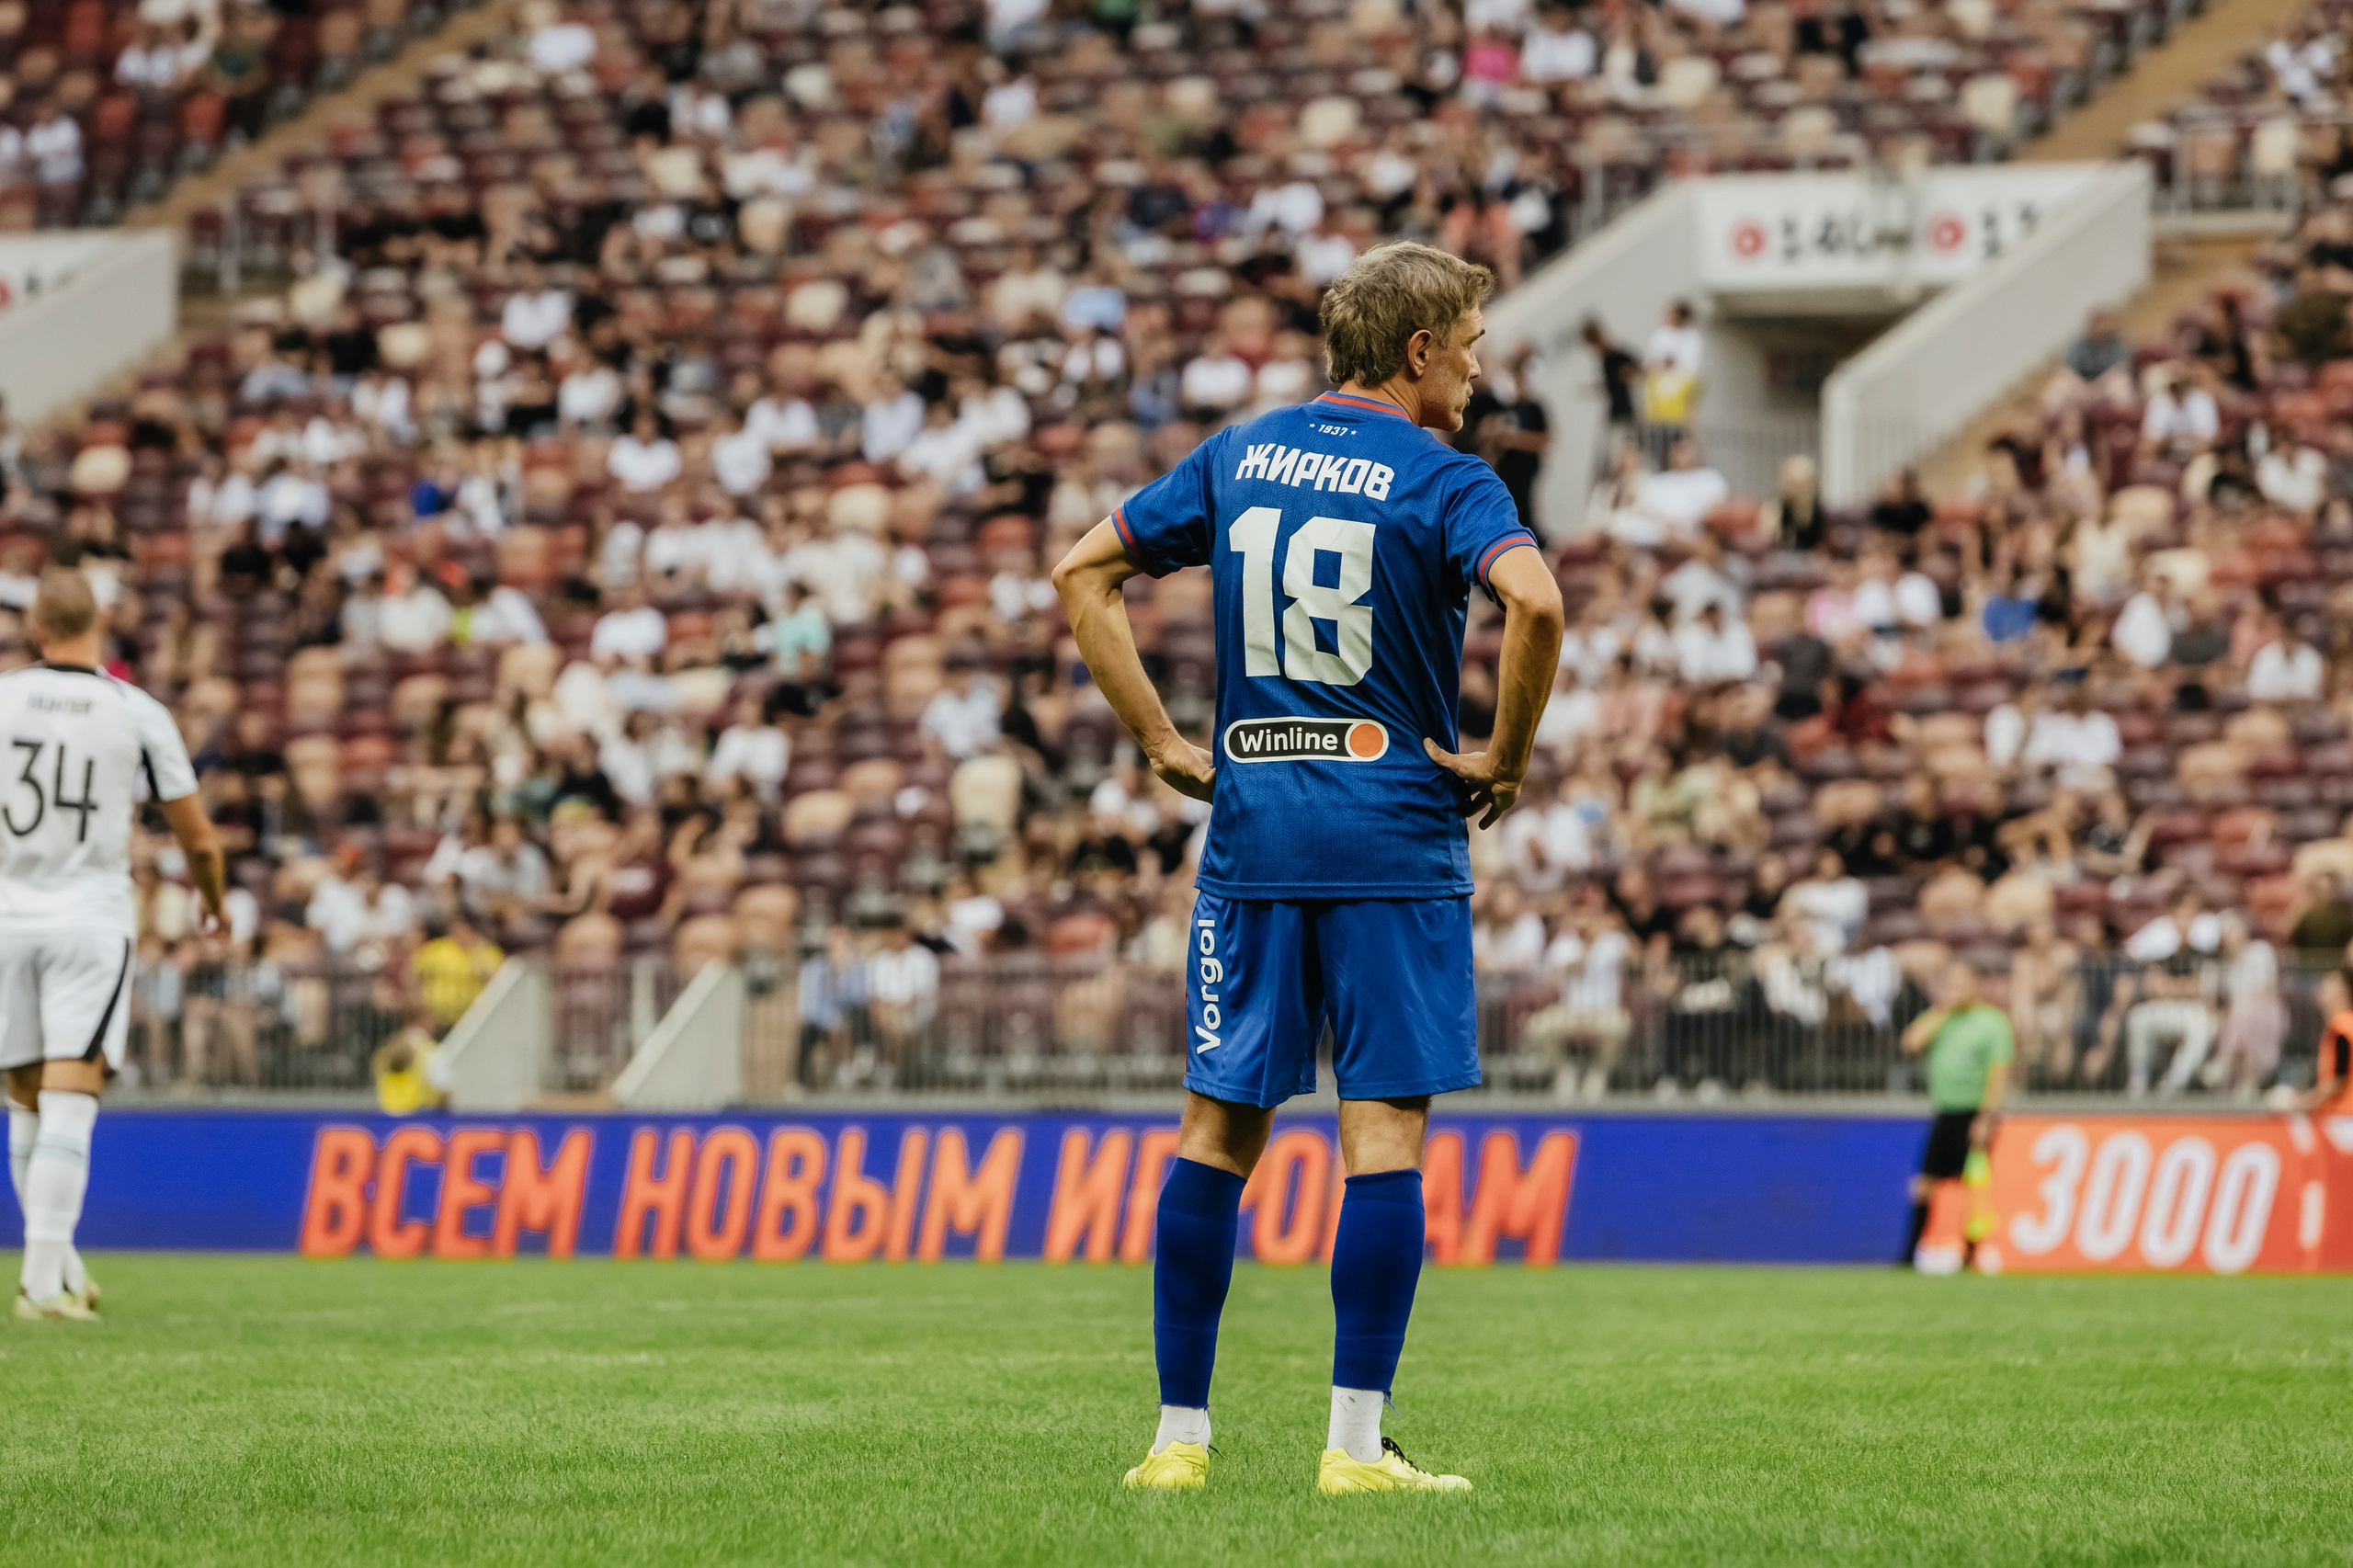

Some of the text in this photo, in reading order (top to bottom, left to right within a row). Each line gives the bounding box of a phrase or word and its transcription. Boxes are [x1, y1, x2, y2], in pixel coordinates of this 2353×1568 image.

[1234, 443, 1395, 502] ЖИРКОВ
[1318, 424, 1348, 437] 1937
[1228, 506, 1377, 687] 18
[3, 740, 98, 843] 34
[1238, 726, 1338, 753] Winline
[1195, 919, 1223, 1054] Vorgol
[299, 1127, 594, 1260] ВСЕМ
[612, 1128, 1025, 1263] НОВЫМ
[2009, 1123, 2282, 1273] 3000
